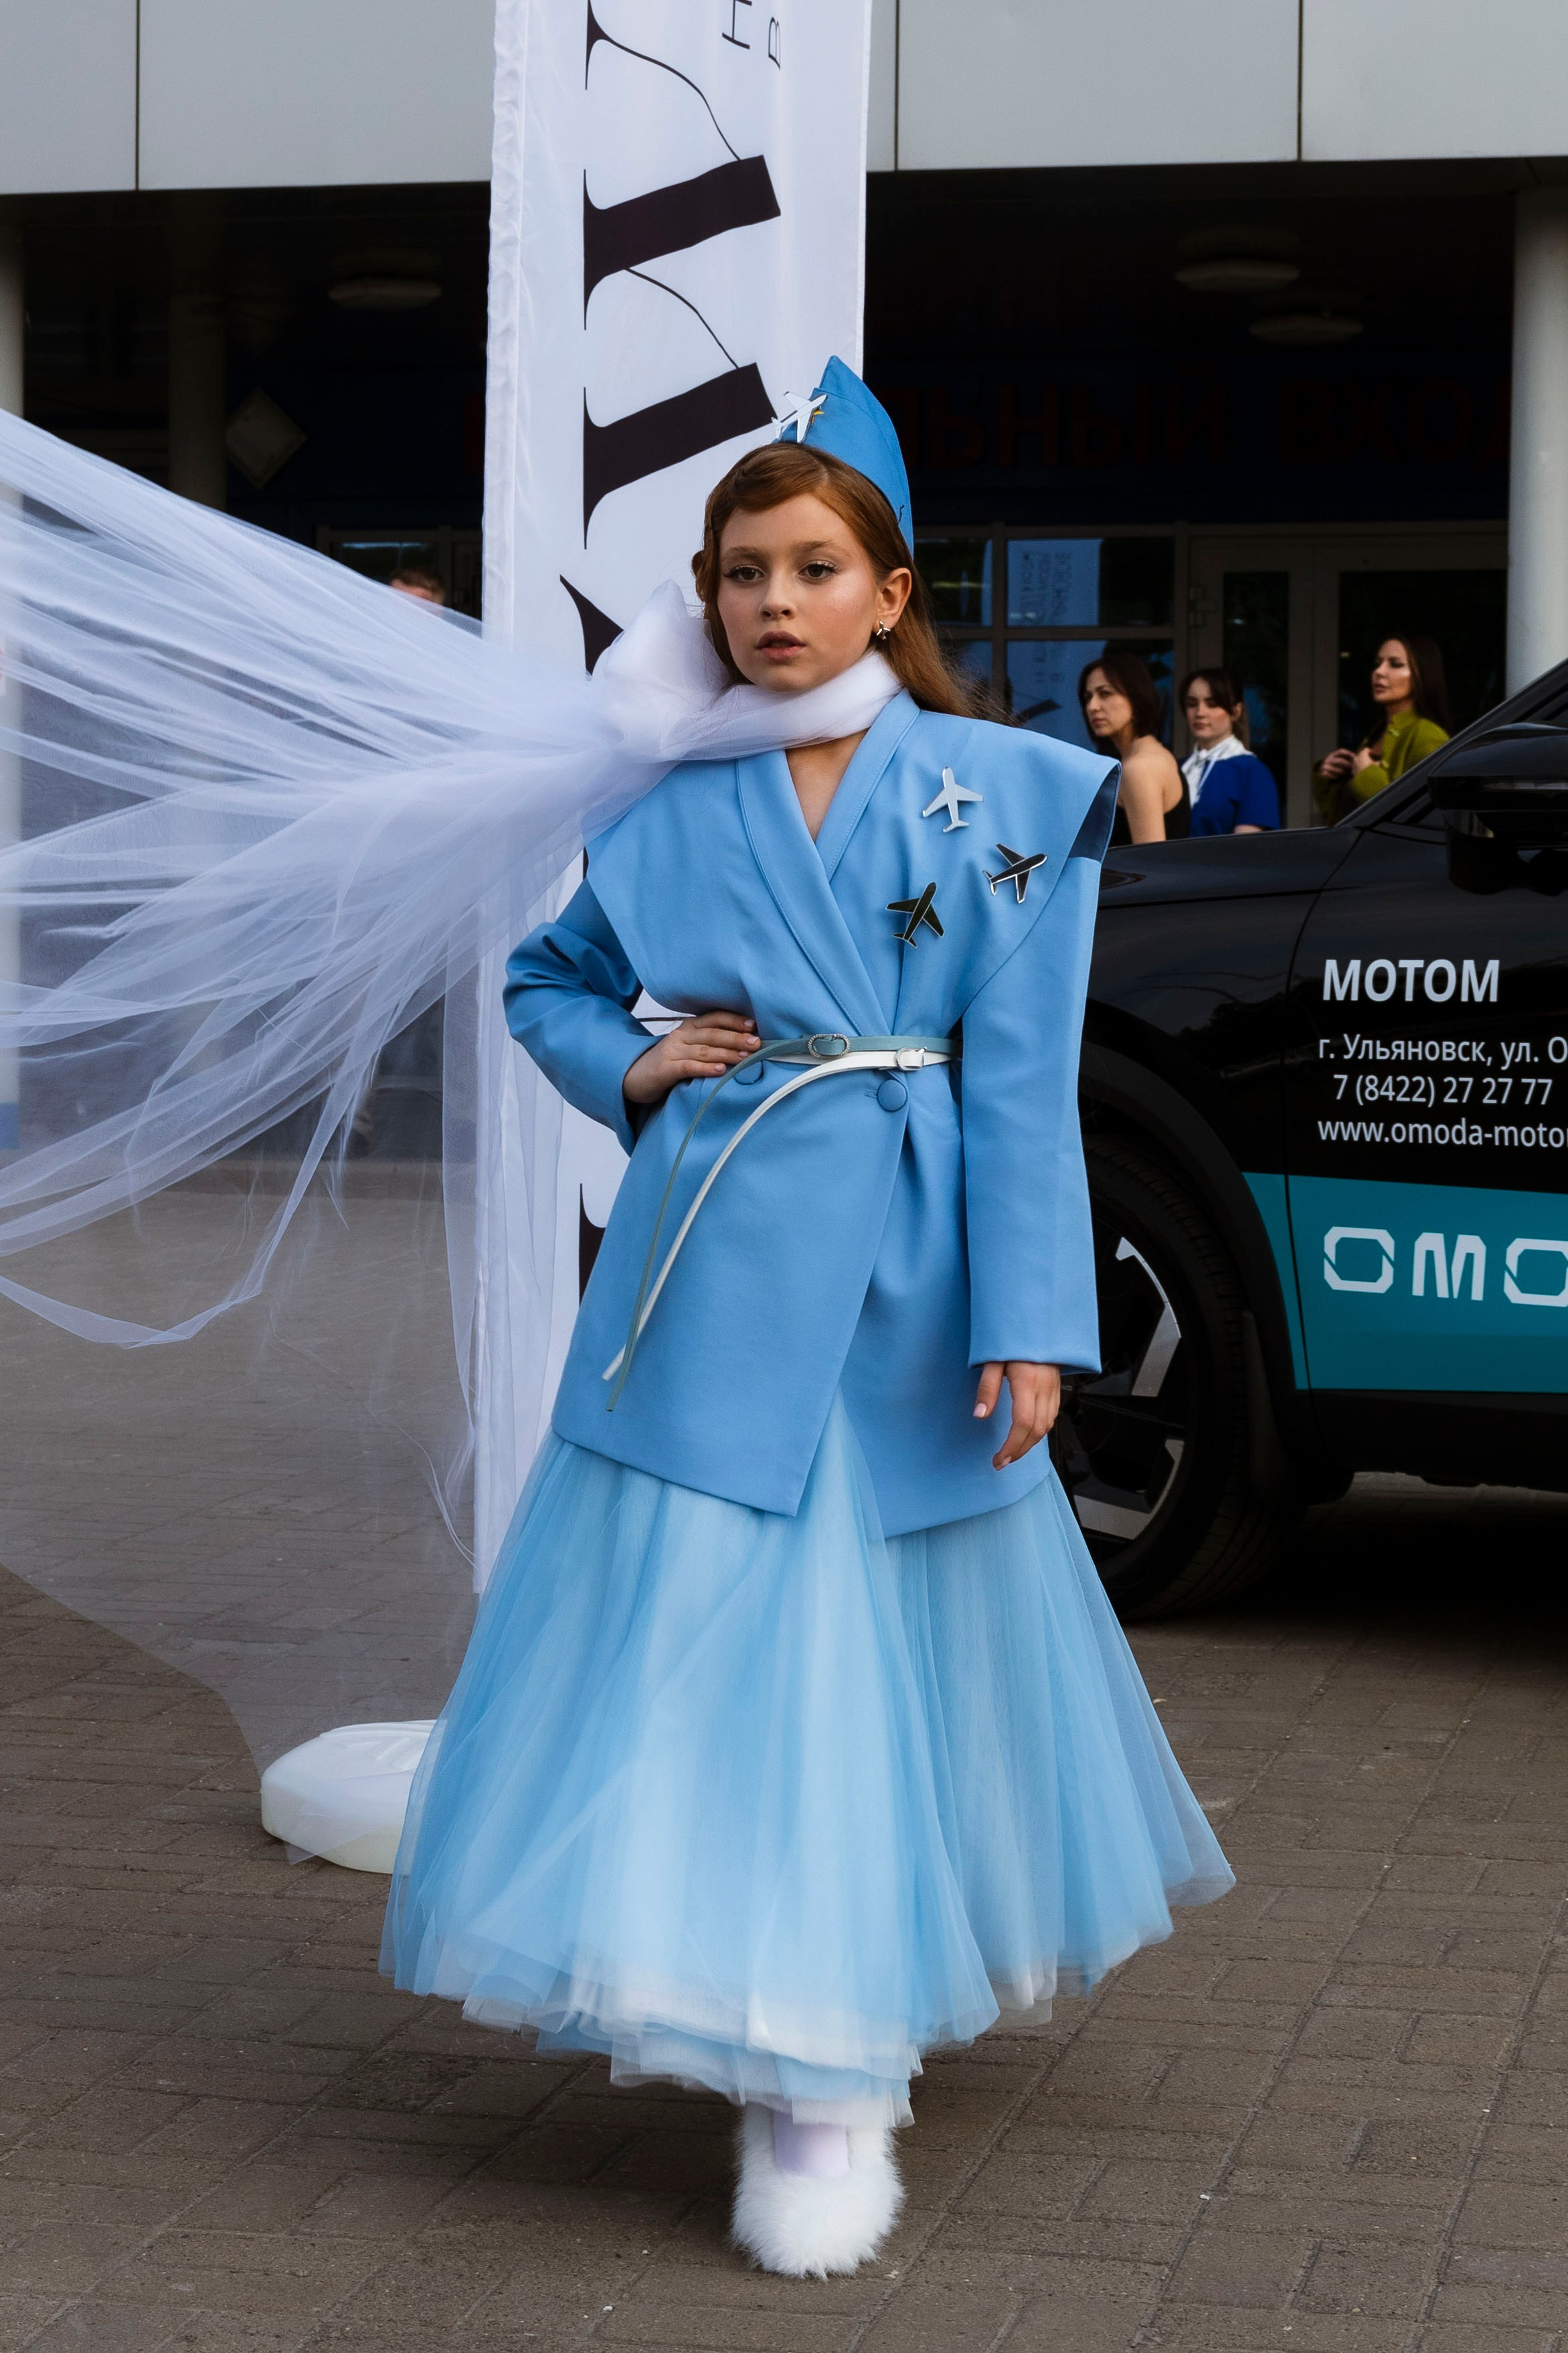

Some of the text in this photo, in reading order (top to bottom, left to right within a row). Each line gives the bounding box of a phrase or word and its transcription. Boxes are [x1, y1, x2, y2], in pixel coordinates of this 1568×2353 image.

[871, 361, 1229, 468] ЛЬНЫЙ
[1319, 1039, 1334, 1059] г.
[1343, 1034, 1492, 1066] Ульяновск,
[1500, 1042, 1539, 1070] ул.
[1333, 1074, 1553, 1108] 7 (8422) 27 27 77
[1317, 1117, 1568, 1148] www.omoda-moto
